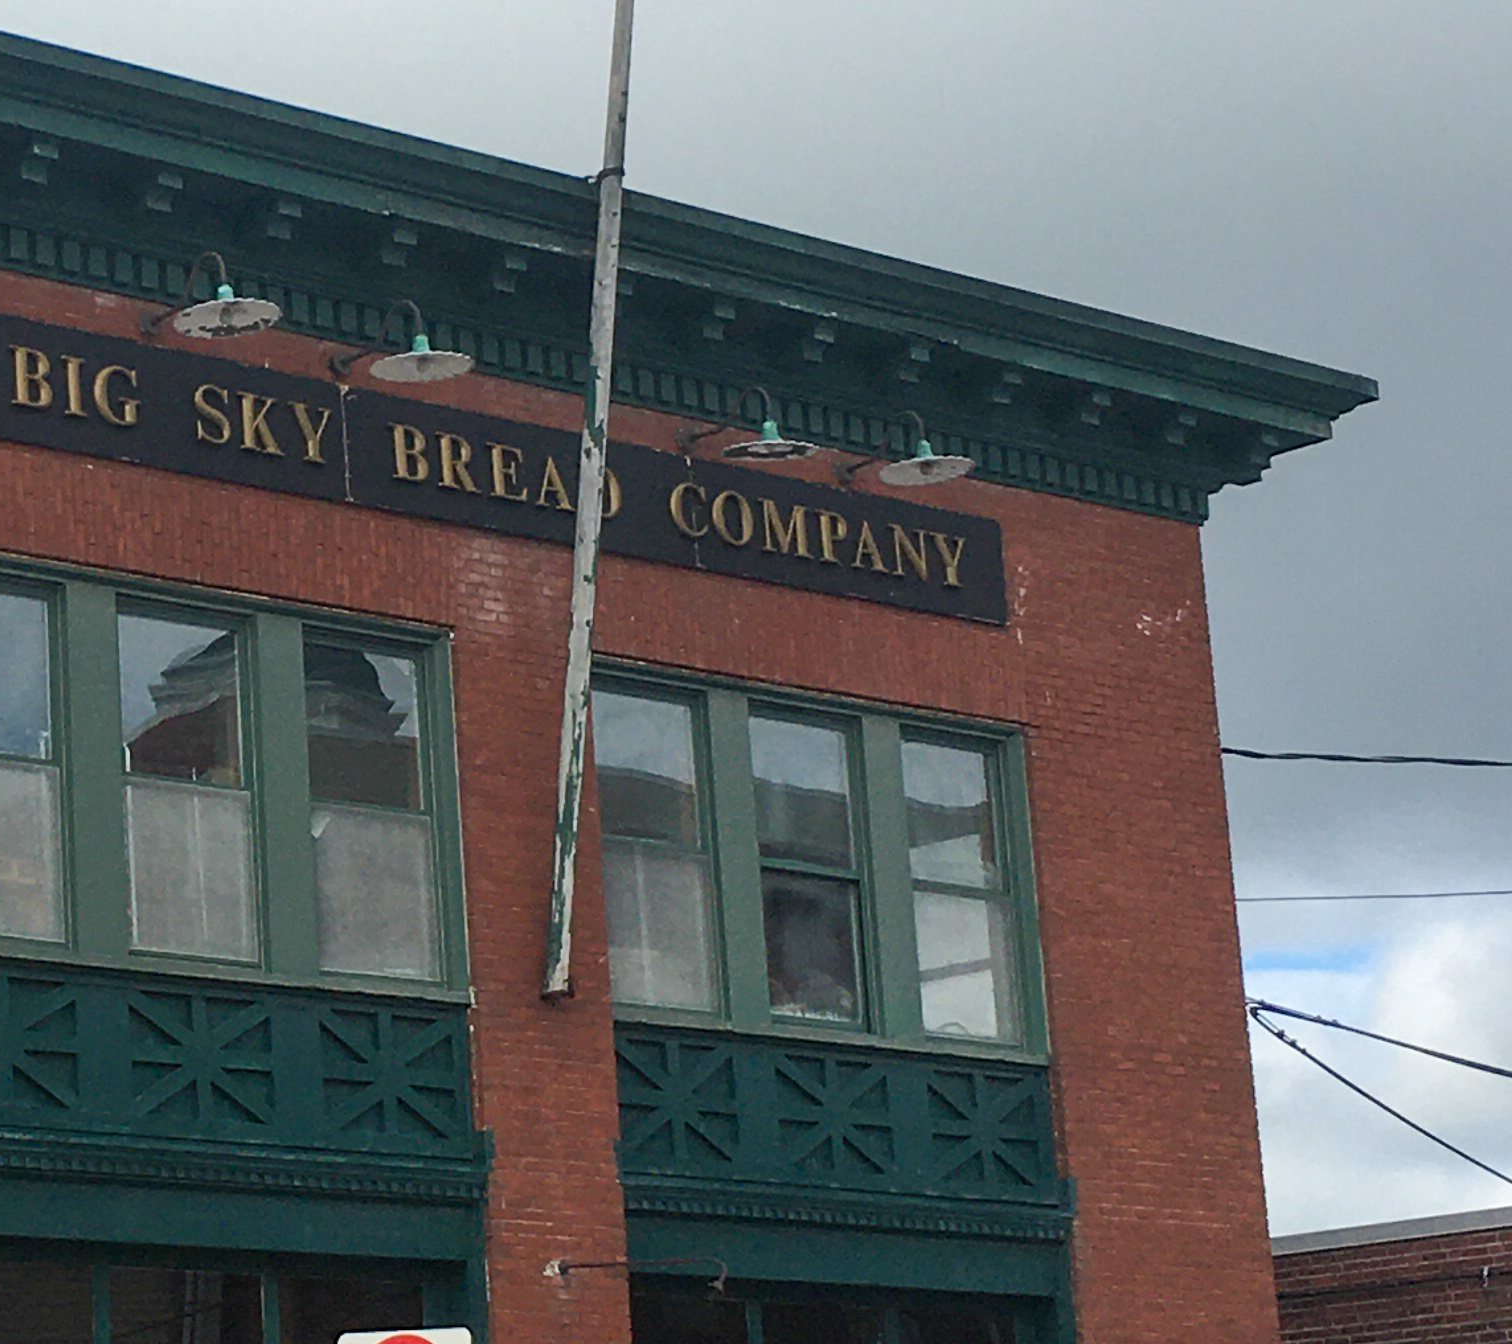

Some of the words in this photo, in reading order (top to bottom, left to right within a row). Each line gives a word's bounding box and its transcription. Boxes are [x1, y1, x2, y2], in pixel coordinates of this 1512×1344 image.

[10, 344, 141, 427] BIG
[193, 383, 332, 465] SKY
[669, 482, 966, 587] COMPANY
